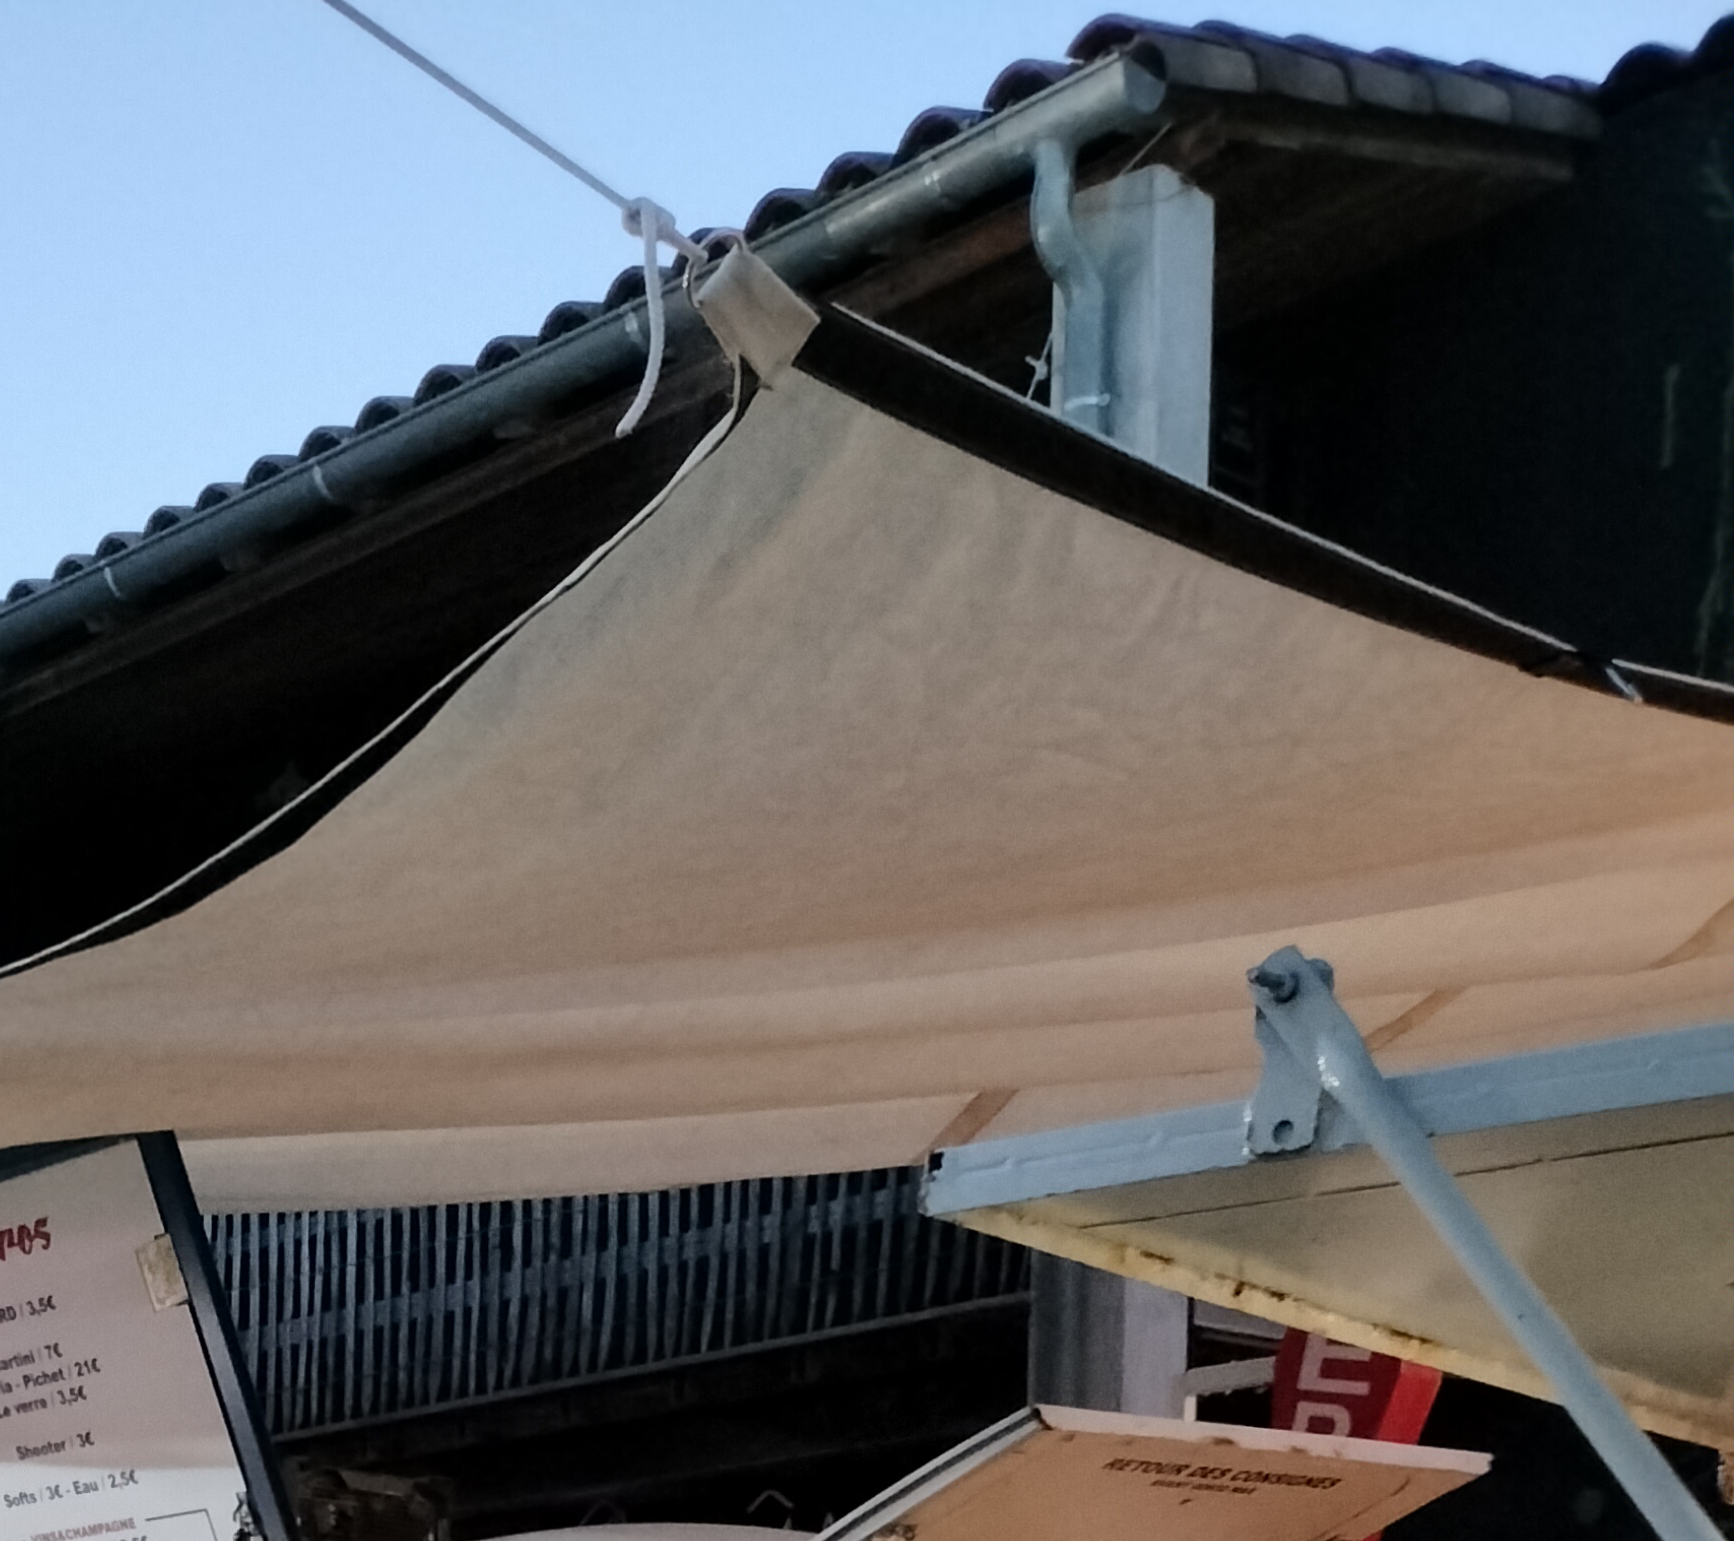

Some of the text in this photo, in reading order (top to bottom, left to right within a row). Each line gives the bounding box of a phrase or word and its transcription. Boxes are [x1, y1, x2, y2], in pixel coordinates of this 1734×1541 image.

[26, 1295, 57, 1317] 3,5€
[44, 1342, 62, 1359] 7€
[22, 1368, 66, 1389] Pichet
[74, 1358, 101, 1377] 21€
[14, 1398, 47, 1414] verre
[57, 1385, 87, 1406] 3,5€
[16, 1431, 95, 1460] Shooter 3€
[1102, 1458, 1342, 1489] RETOUR DES CONSIGNES
[4, 1469, 138, 1508] Softs 3€ Eau 2,5€
